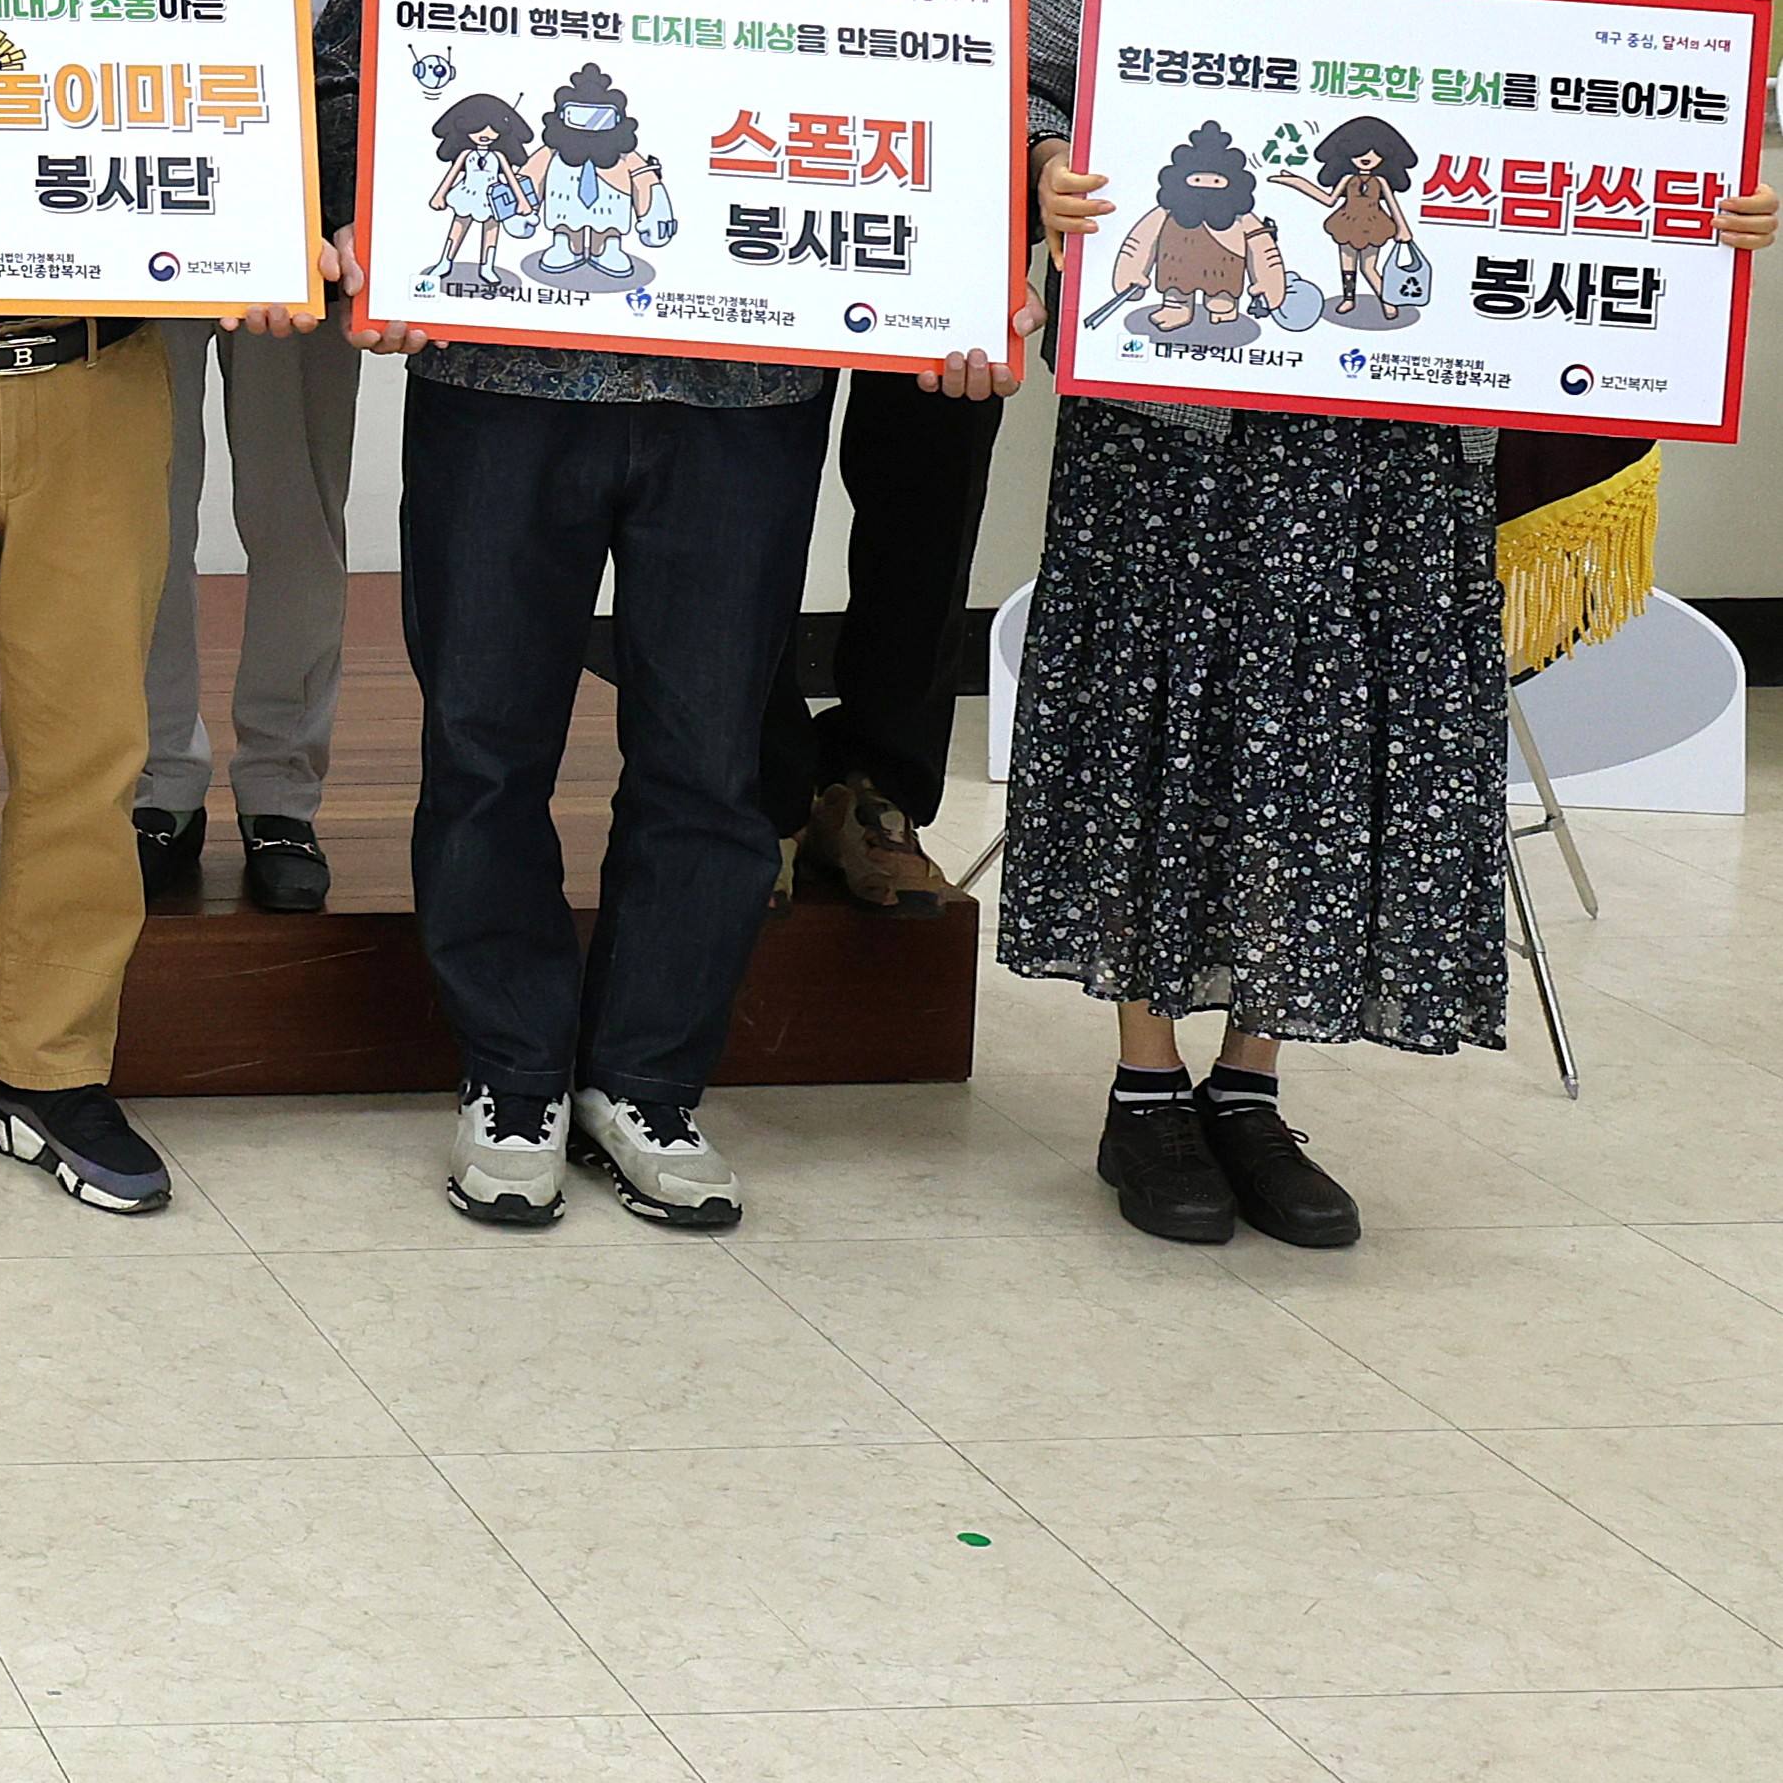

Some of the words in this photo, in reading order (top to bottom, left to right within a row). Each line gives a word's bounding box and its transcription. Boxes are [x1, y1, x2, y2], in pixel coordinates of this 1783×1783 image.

[397, 1, 517, 34] 어르신이
[529, 8, 622, 40] 행복한
[632, 15, 725, 49] 디지털
[734, 22, 826, 53] 세상을
[838, 28, 992, 64] 만들어가는
[1596, 32, 1621, 44] 대구
[1628, 33, 1657, 49] 중심,
[1663, 36, 1699, 50] 달서의
[1704, 40, 1731, 52] 시대
[1118, 47, 1299, 93] 환경정화로
[1310, 61, 1420, 103] 깨끗한
[1432, 69, 1537, 108] 달서를
[1551, 77, 1729, 124] 만들어가는
[709, 110, 932, 192] 스폰지
[35, 155, 219, 214] 봉사단
[1419, 154, 1731, 247] 쓰담쓰담
[726, 204, 917, 275] 봉사단
[27, 254, 74, 263] 가정복지회
[188, 261, 251, 274] 보건복지부
[445, 277, 531, 302] 대구광역시
[538, 282, 590, 306] 달서구
[656, 292, 715, 308] 사회복지법인
[719, 297, 767, 309] 가정복지회
[1471, 256, 1666, 325] 봉사단
[656, 298, 795, 326] 달서구노인종합복지관
[885, 314, 950, 330] 보건복지부
[14, 348, 33, 366] B
[1155, 341, 1242, 364] 대구광역시
[1249, 349, 1302, 367] 달서구
[1370, 353, 1430, 366] 사회복지법인
[1434, 358, 1484, 371] 가정복지회
[1370, 359, 1511, 388] 달서구노인종합복지관
[1601, 376, 1667, 392] 보건복지부
